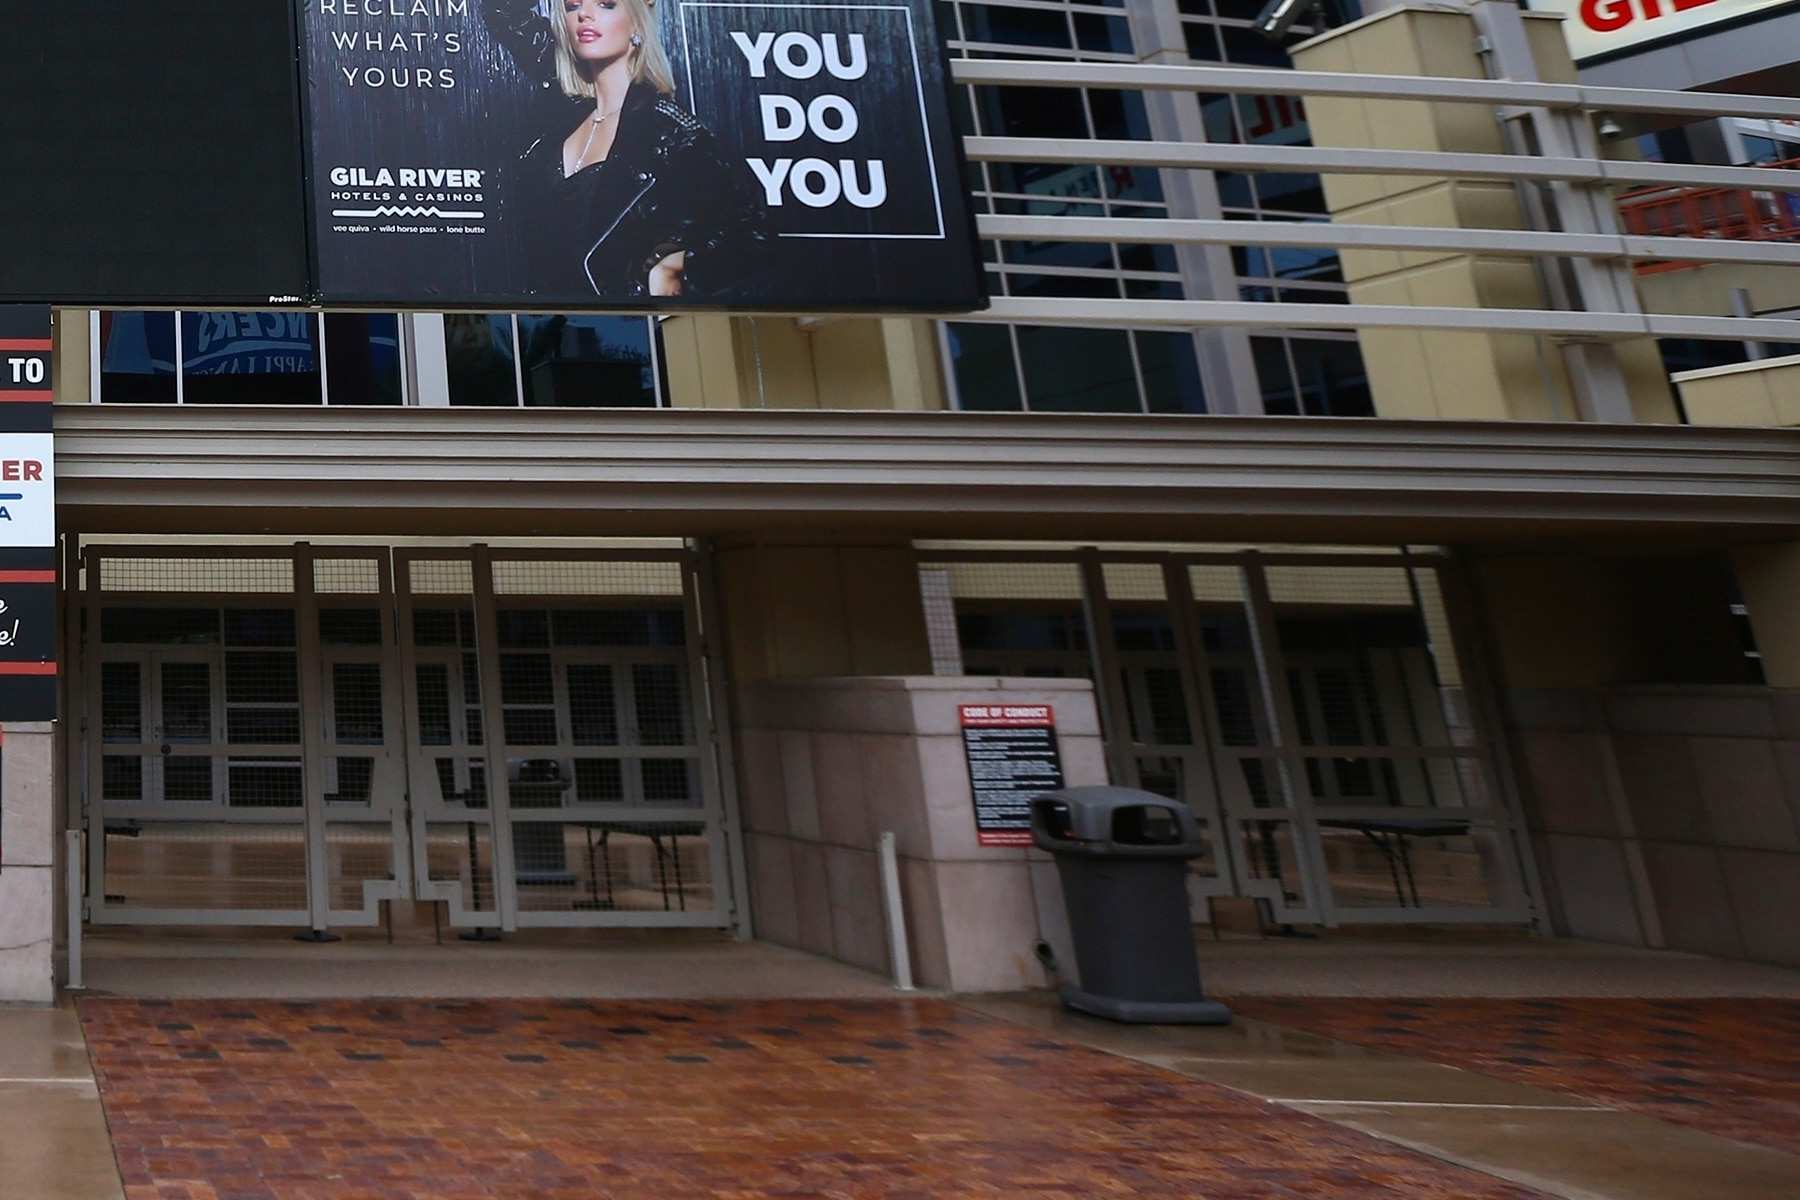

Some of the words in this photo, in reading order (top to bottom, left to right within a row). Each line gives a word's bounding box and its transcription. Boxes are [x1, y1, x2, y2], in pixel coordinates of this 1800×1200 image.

[331, 30, 462, 54] WHAT'S
[730, 30, 868, 81] YOU
[342, 66, 456, 90] YOURS
[759, 93, 860, 143] DO
[330, 167, 395, 187] GILA
[400, 168, 482, 188] RIVER
[745, 156, 889, 208] YOU
[331, 191, 391, 201] HOTELS
[398, 192, 408, 201] &
[415, 193, 484, 202] CASINOS
[348, 224, 370, 233] quiva
[379, 225, 396, 233] wild
[397, 225, 418, 233] horse
[464, 226, 486, 234] butte
[8, 357, 45, 384] TO
